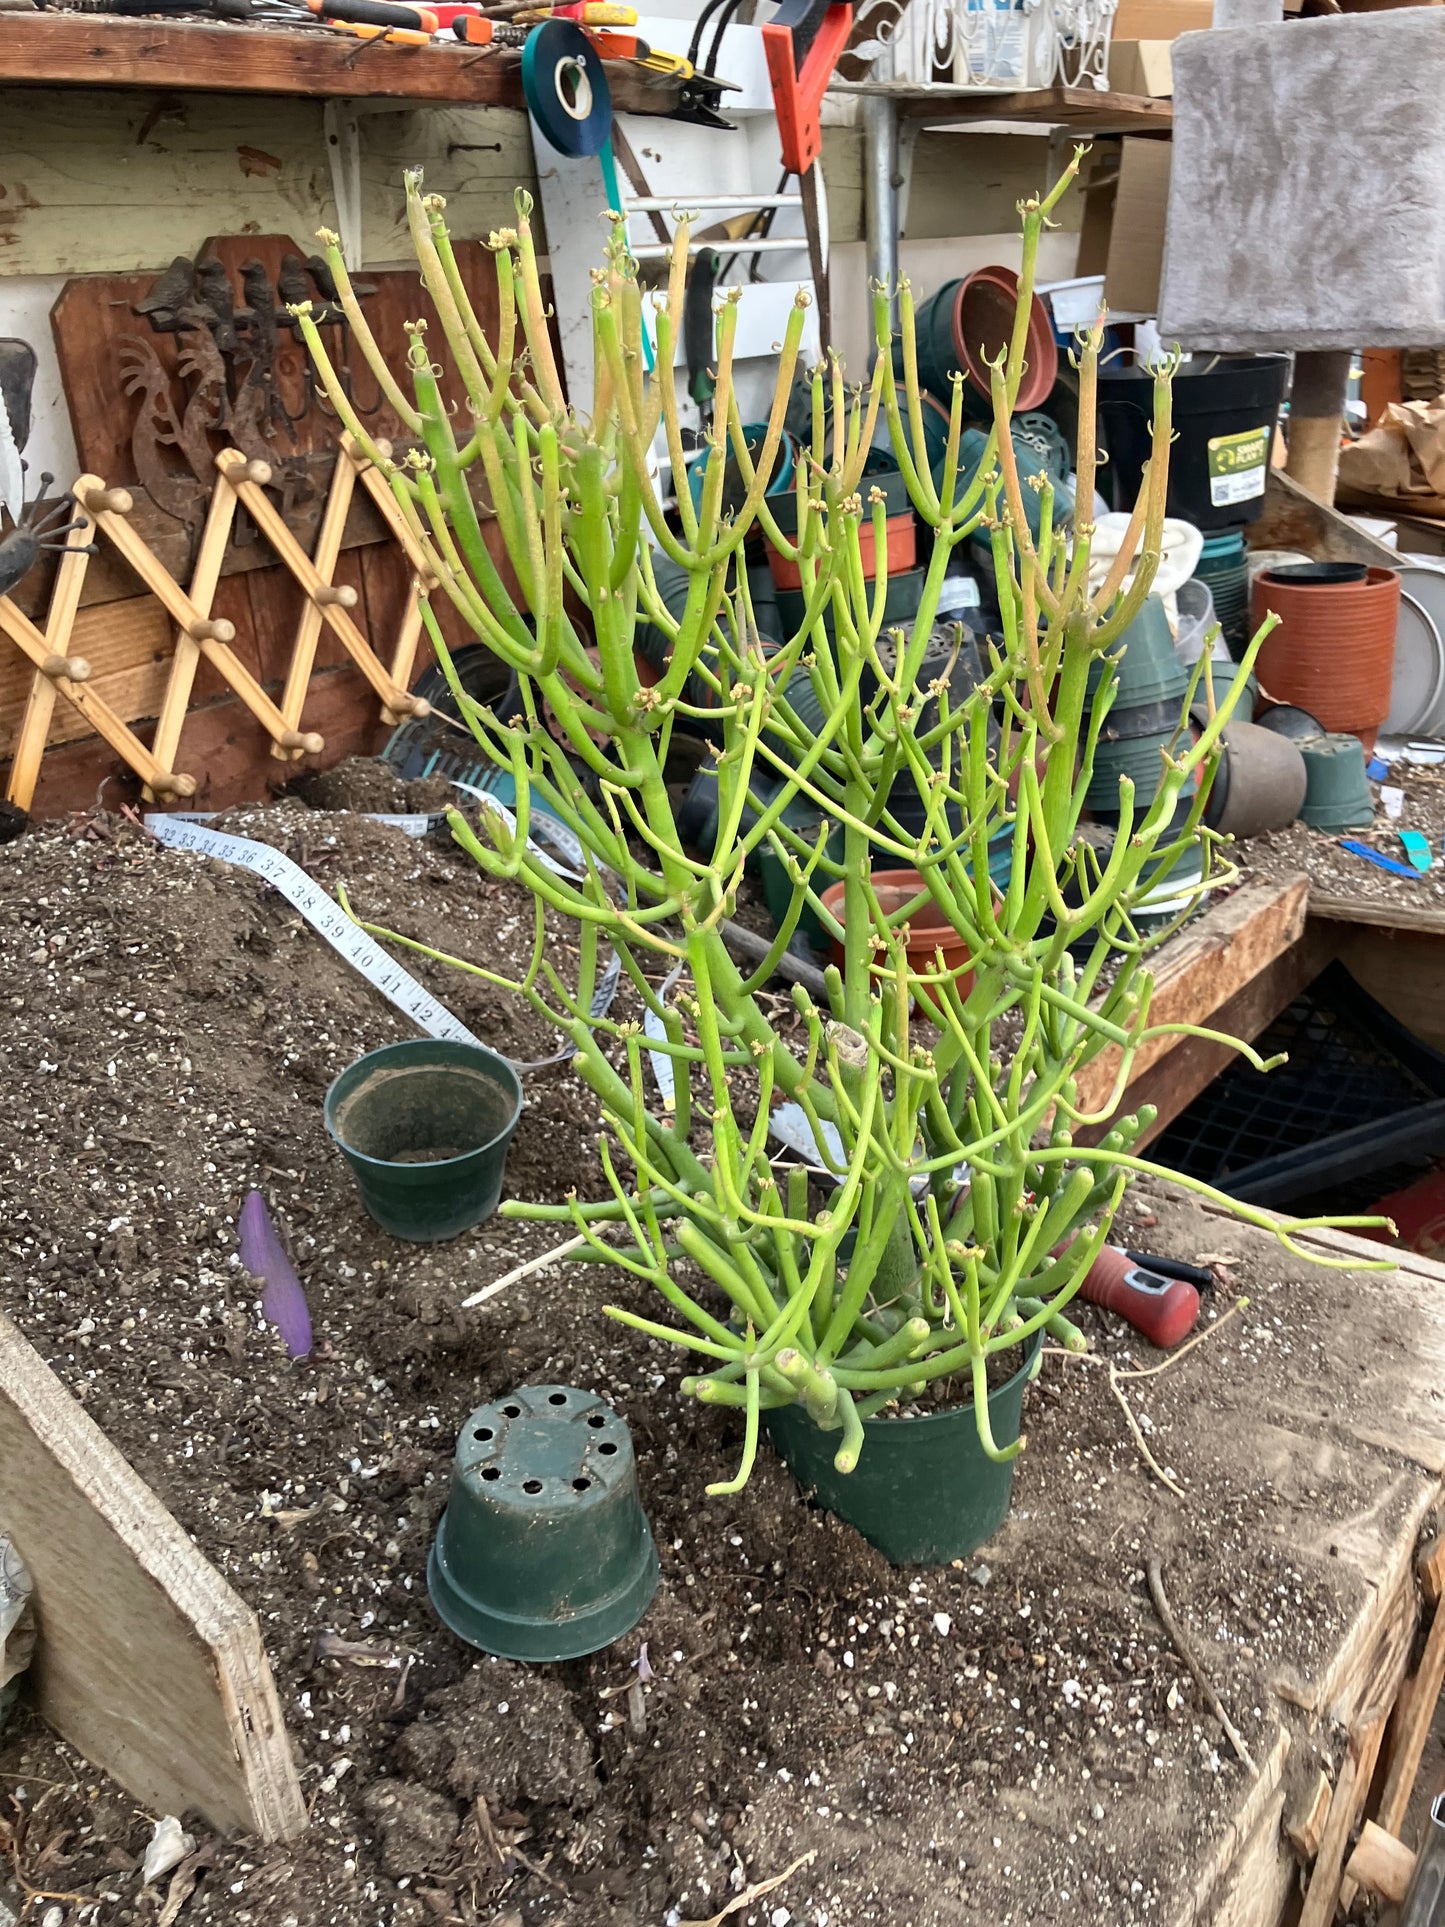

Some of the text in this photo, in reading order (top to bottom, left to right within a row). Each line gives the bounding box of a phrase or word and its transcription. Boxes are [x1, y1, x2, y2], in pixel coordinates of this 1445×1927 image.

[160, 827, 176, 841] 32
[179, 833, 196, 848] 33
[197, 840, 216, 853] 34
[219, 845, 236, 858] 35
[238, 850, 257, 863] 36
[261, 859, 286, 878] 37
[292, 886, 316, 910] 38
[321, 915, 345, 938] 39
[351, 946, 374, 968] 40
[380, 974, 402, 994] 41
[410, 1001, 433, 1022] 42
